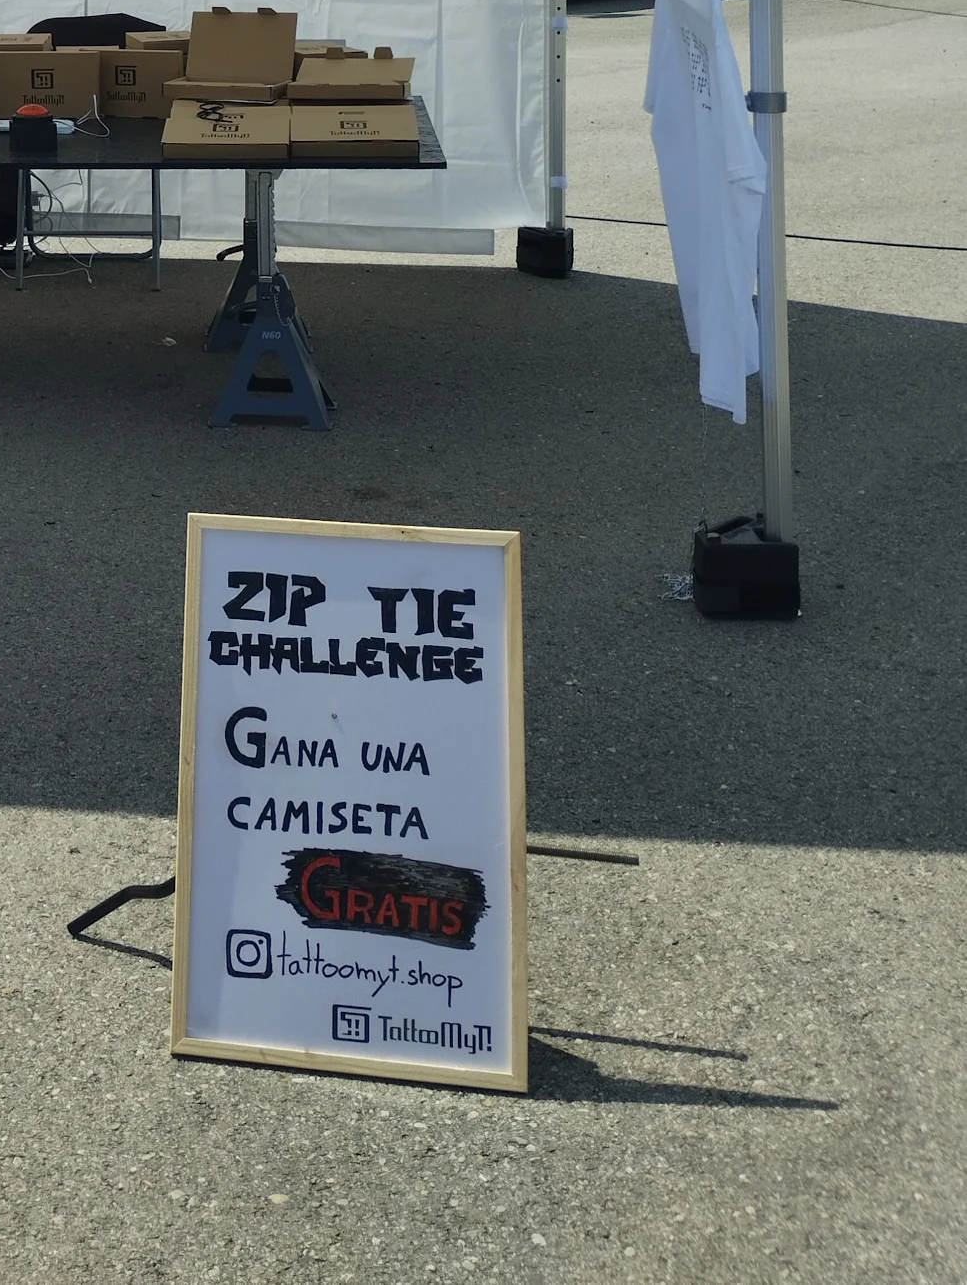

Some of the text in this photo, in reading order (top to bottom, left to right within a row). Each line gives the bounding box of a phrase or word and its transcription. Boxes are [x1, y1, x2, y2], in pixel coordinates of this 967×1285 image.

[261, 331, 281, 340] N60
[222, 571, 476, 640] ZIP TIE
[207, 631, 484, 684] CHALLENGE
[224, 706, 430, 776] GANA UNA
[227, 796, 429, 841] CAMISETA
[300, 855, 465, 936] GRATIS
[277, 930, 464, 1008] tattoomyt.shop
[378, 1015, 493, 1055] TattooMyT!
